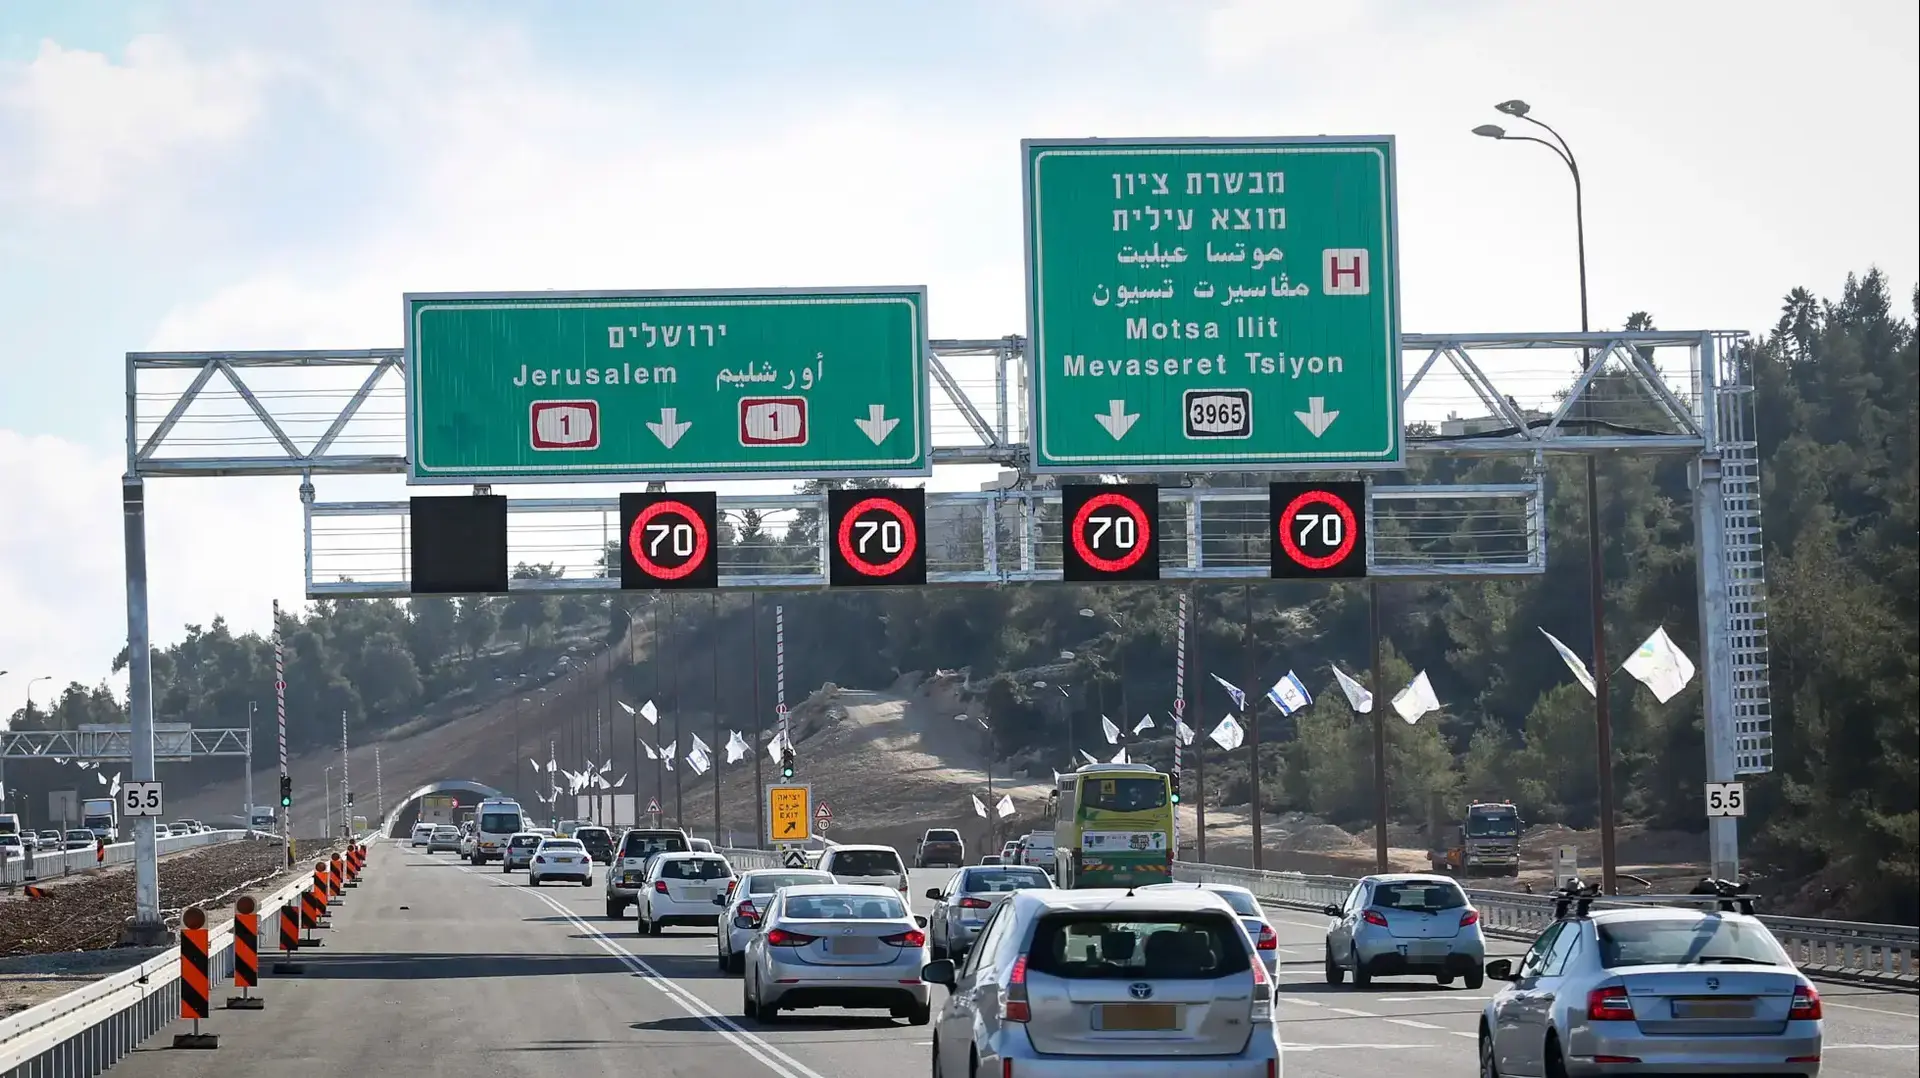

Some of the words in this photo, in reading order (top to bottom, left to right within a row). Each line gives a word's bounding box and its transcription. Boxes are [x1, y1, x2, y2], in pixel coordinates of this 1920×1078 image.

[1113, 173, 1169, 198] ציון
[1187, 172, 1285, 195] מבשרת
[1113, 205, 1193, 231] עילית
[1212, 207, 1286, 230] מוצא
[1117, 242, 1188, 269] عيليت
[1206, 242, 1284, 270] موتسا
[1331, 256, 1361, 288] H
[1092, 279, 1174, 308] تسيون
[607, 322, 727, 348] ירושלים
[1126, 317, 1219, 340] Motsa
[1238, 316, 1278, 338] Ilit
[513, 362, 677, 387] Jerusalem
[716, 352, 823, 391] أورشليم
[1063, 354, 1227, 377] Mevaseret
[1244, 352, 1343, 379] Tsiyon
[559, 414, 570, 436] 1
[768, 410, 779, 432] 1
[1192, 403, 1243, 425] 3965
[646, 524, 693, 557] 70
[854, 520, 901, 554] 70
[1088, 516, 1134, 549] 70
[1295, 514, 1341, 546] 70
[127, 789, 159, 809] 5.5
[1710, 790, 1741, 809] 5.5
